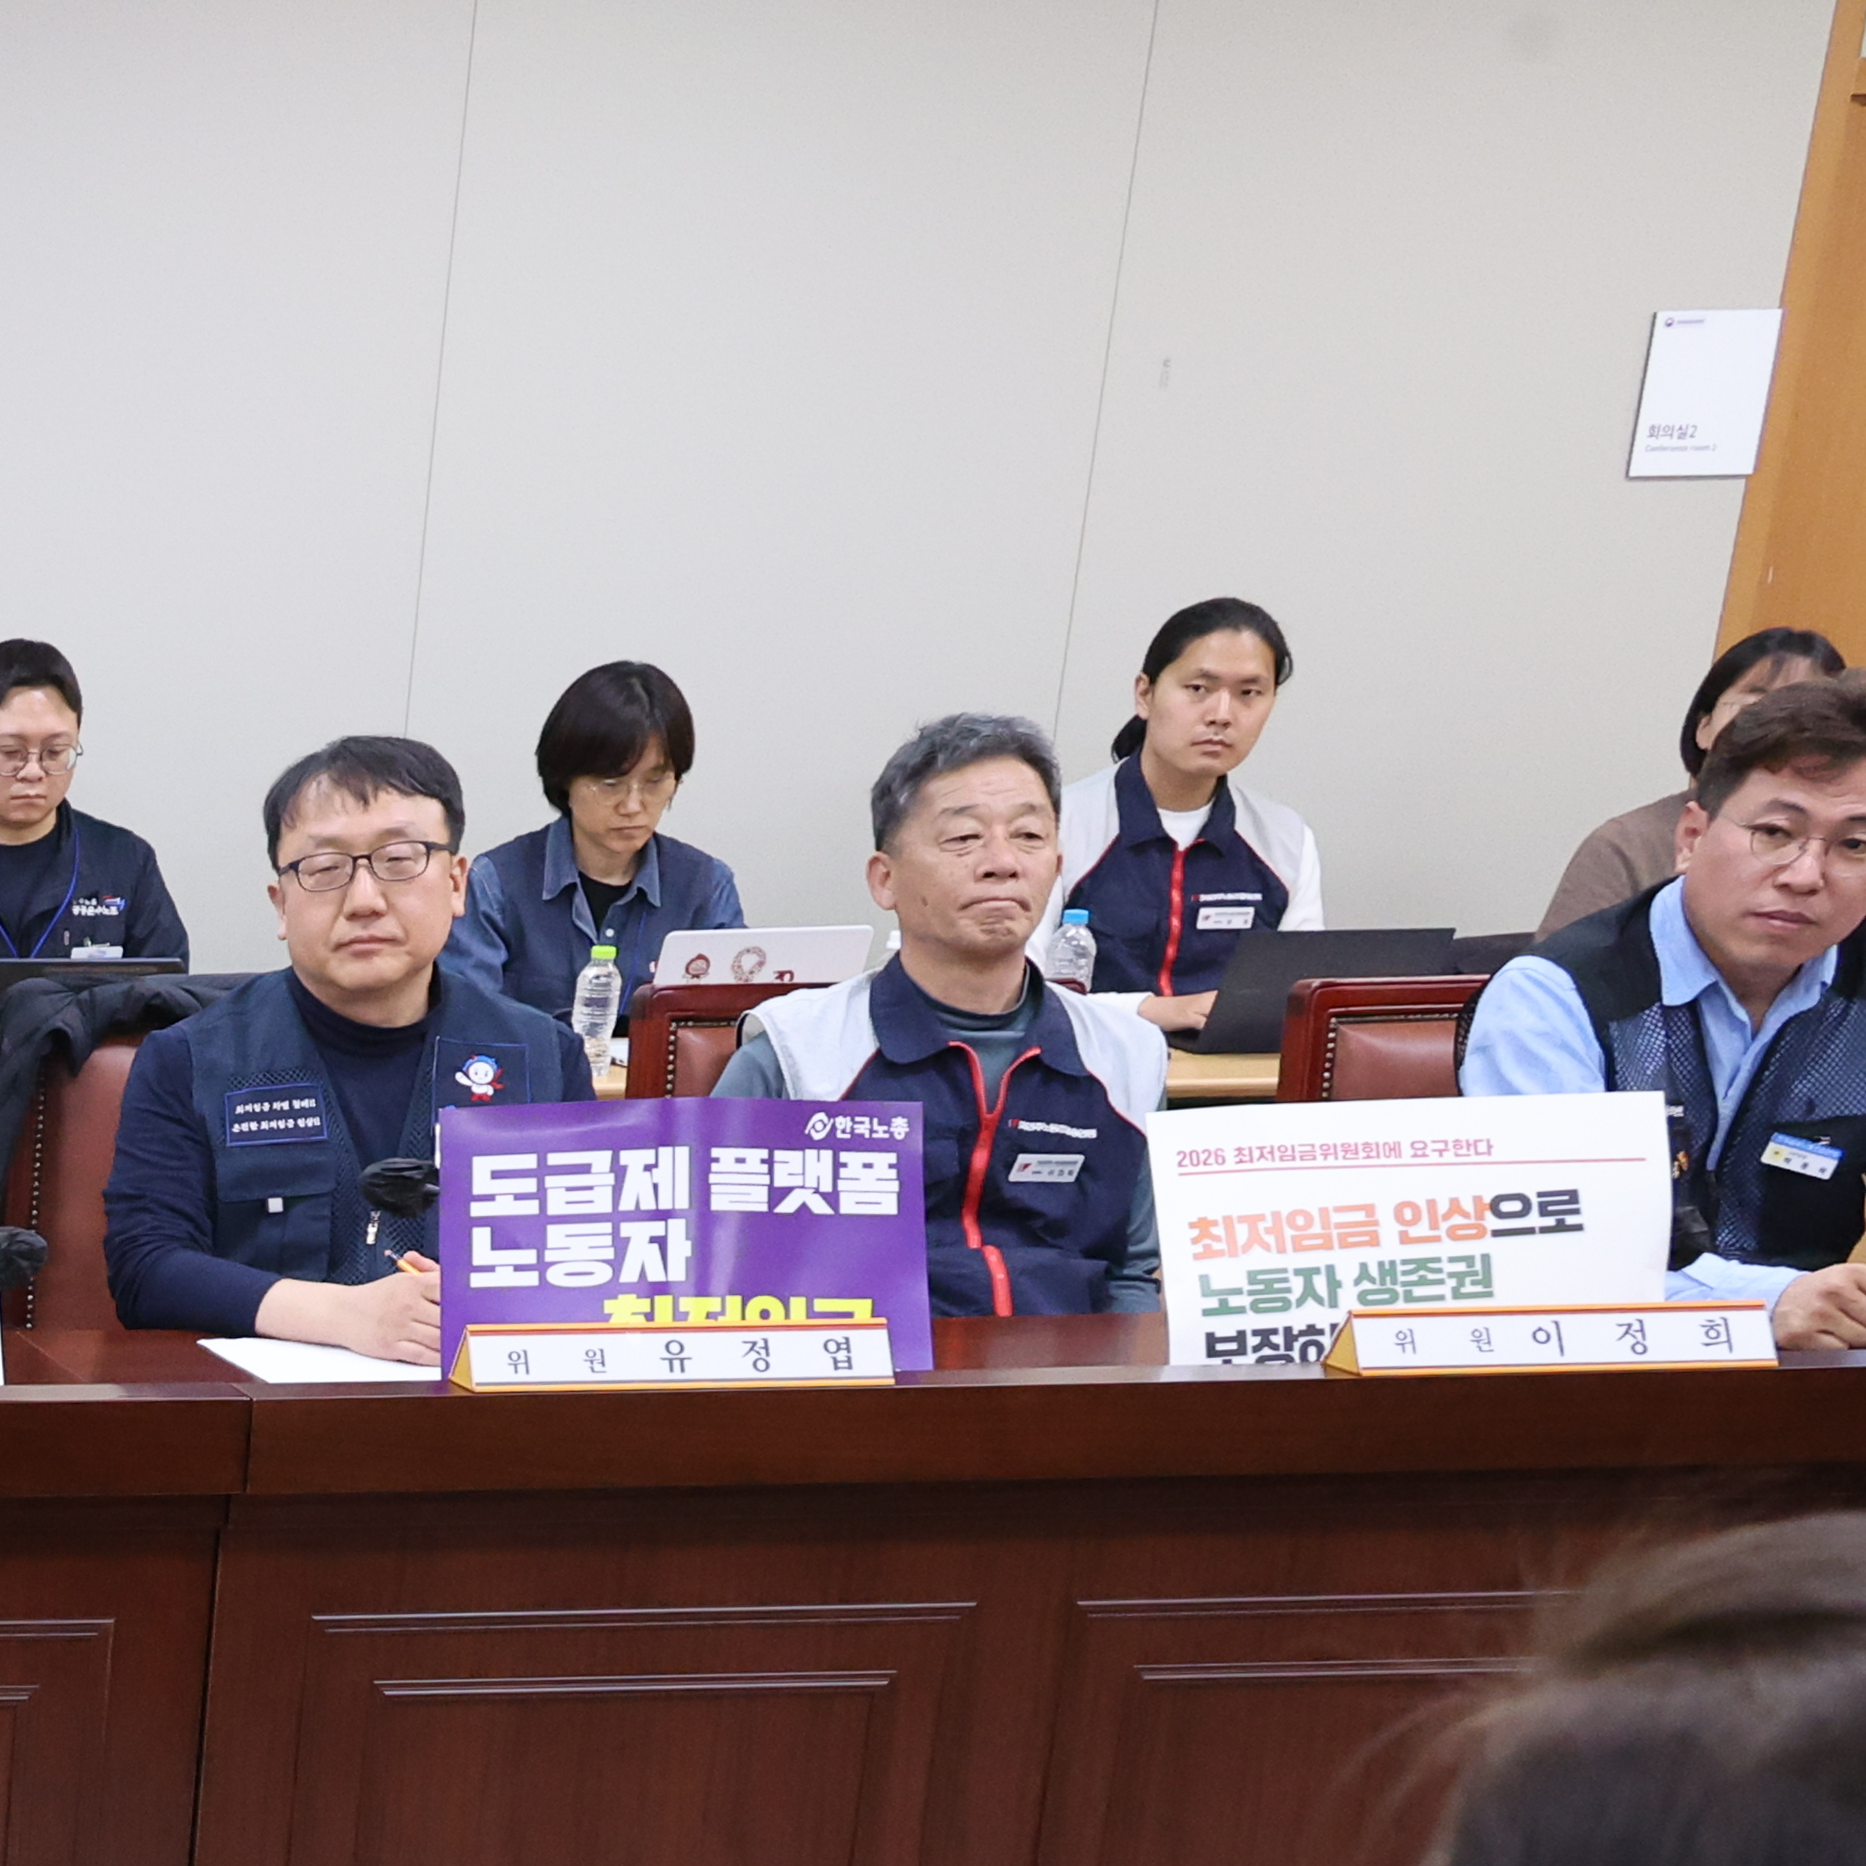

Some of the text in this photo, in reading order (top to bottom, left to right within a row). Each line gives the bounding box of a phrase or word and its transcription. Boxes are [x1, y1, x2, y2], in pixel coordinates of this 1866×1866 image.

[834, 1115, 909, 1140] 한국노총
[1176, 1138, 1494, 1169] 2026 최저임금위원회에 요구한다
[469, 1146, 900, 1218] 도급제 플랫폼
[1189, 1189, 1584, 1261] 최저임금 인상으로
[469, 1219, 692, 1289] 노동자
[1199, 1253, 1495, 1318] 노동자 생존권
[660, 1336, 854, 1373] 유정엽
[1532, 1317, 1734, 1357] 이정희
